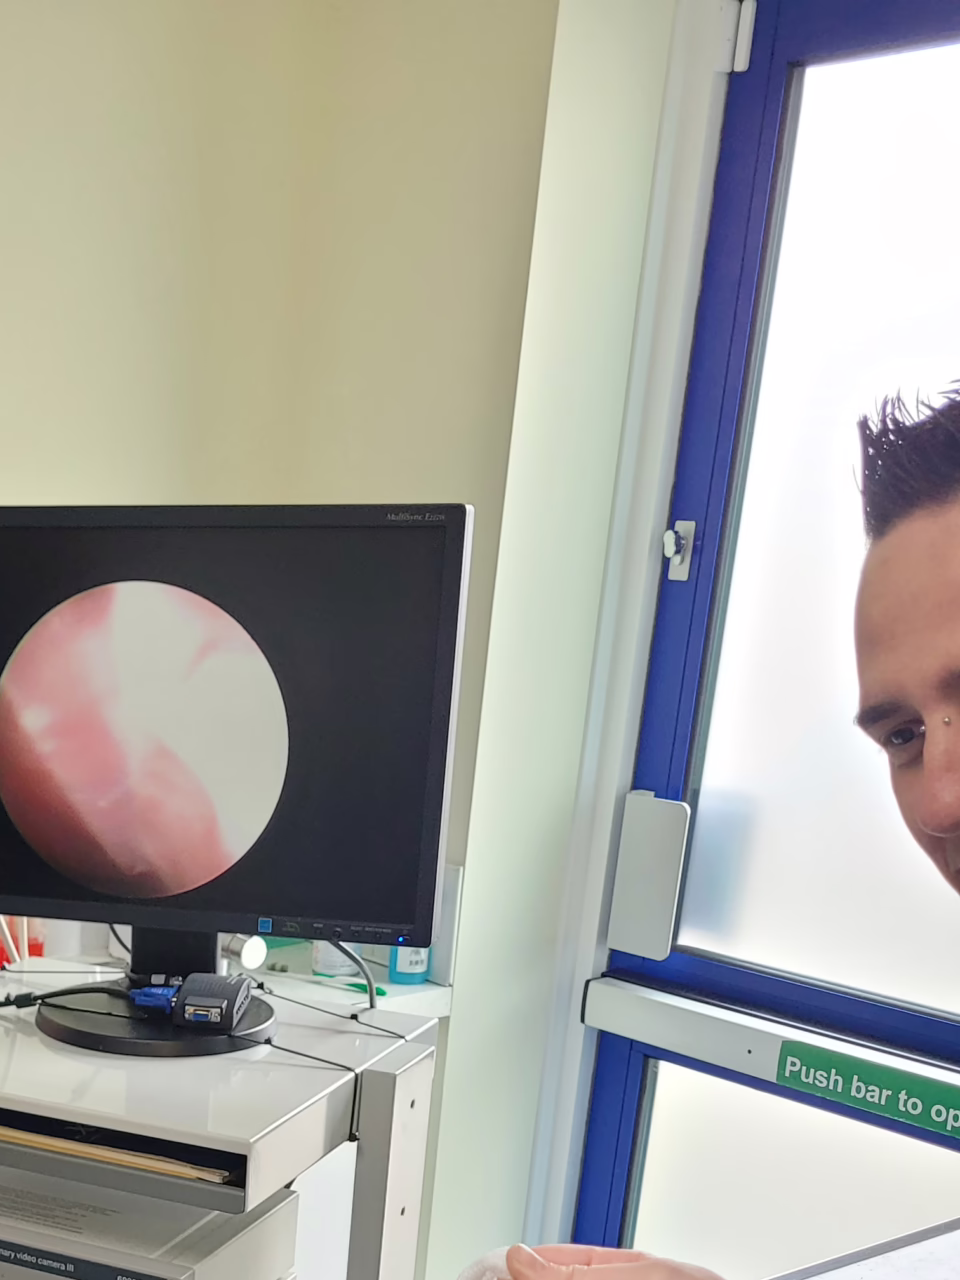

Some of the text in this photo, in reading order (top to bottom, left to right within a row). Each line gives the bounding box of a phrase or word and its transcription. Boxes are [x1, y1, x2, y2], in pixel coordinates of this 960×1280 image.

[784, 1055, 843, 1093] Push
[850, 1074, 893, 1106] bar
[898, 1089, 923, 1115] to
[15, 1251, 37, 1264] video
[37, 1257, 66, 1271] camera
